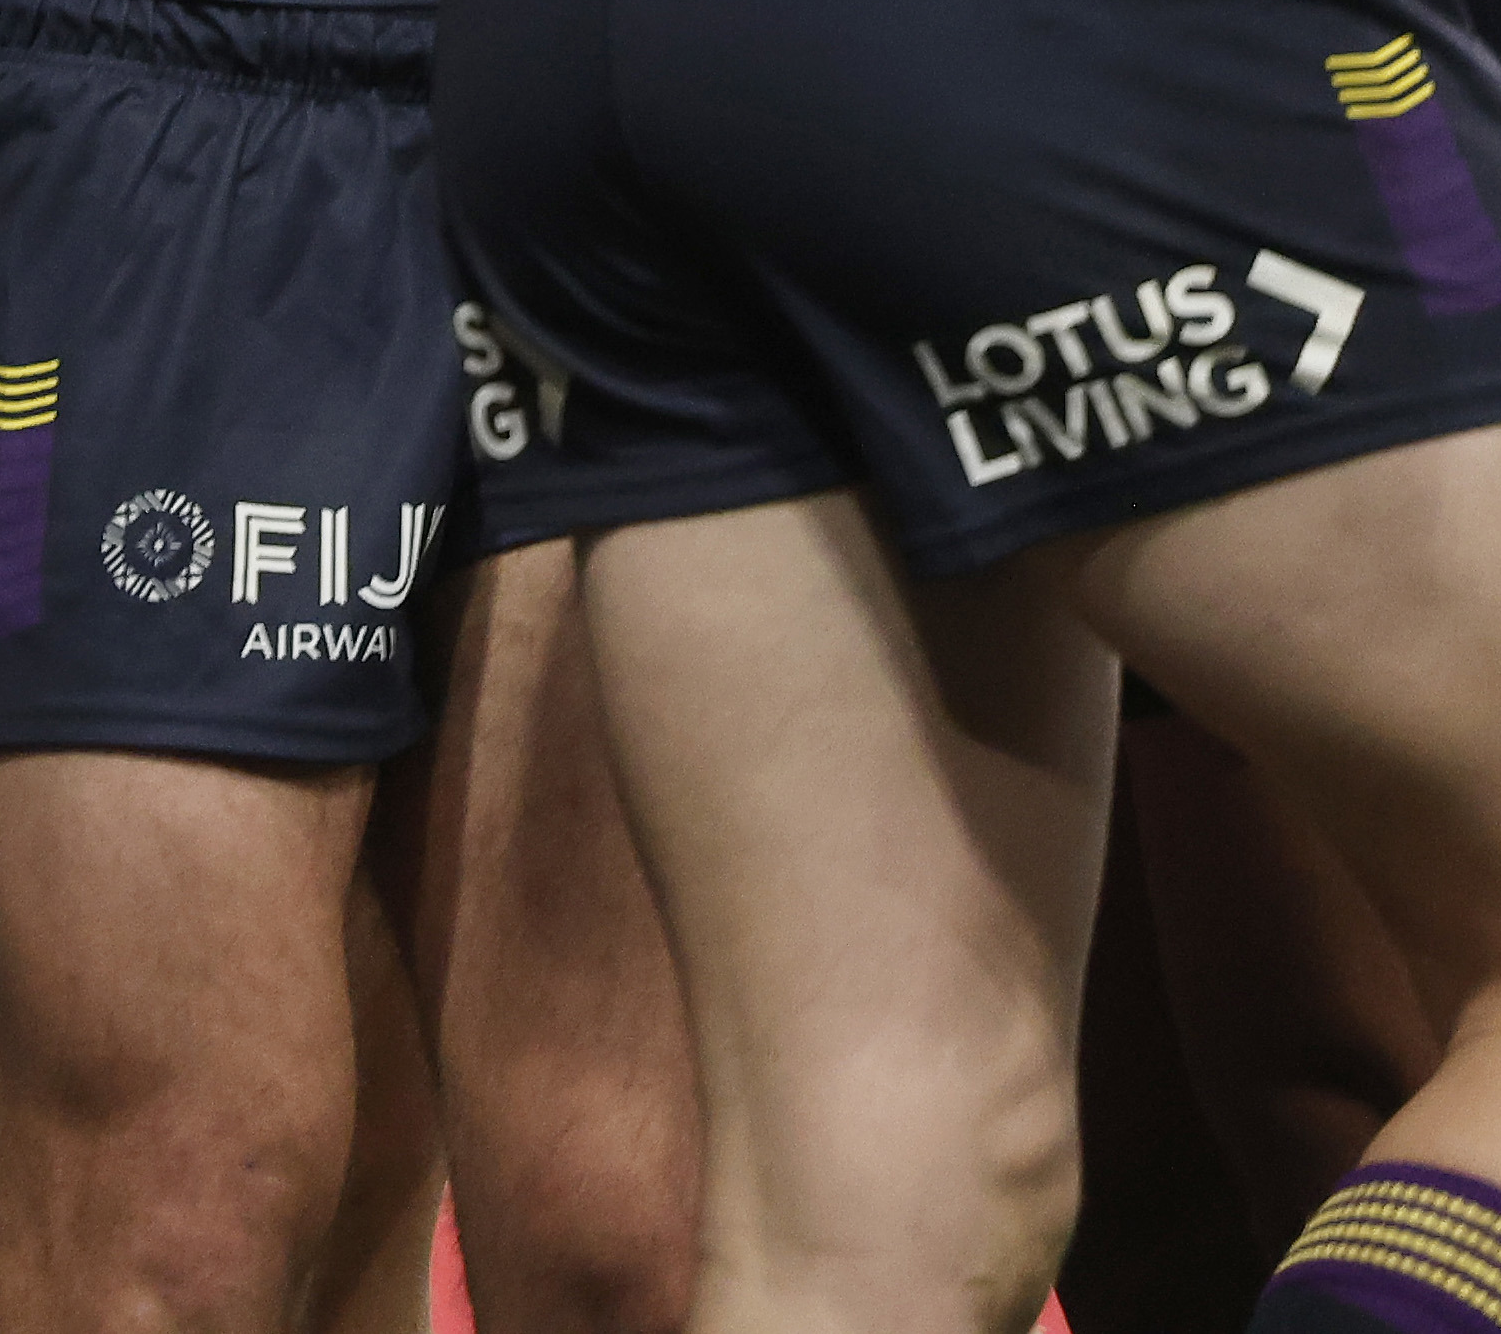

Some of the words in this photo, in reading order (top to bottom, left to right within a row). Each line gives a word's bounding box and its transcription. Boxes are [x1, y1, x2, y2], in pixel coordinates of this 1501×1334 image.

[913, 263, 1236, 409] LOTUS
[946, 345, 1271, 487] LIVING
[241, 622, 396, 663] AIRWA
